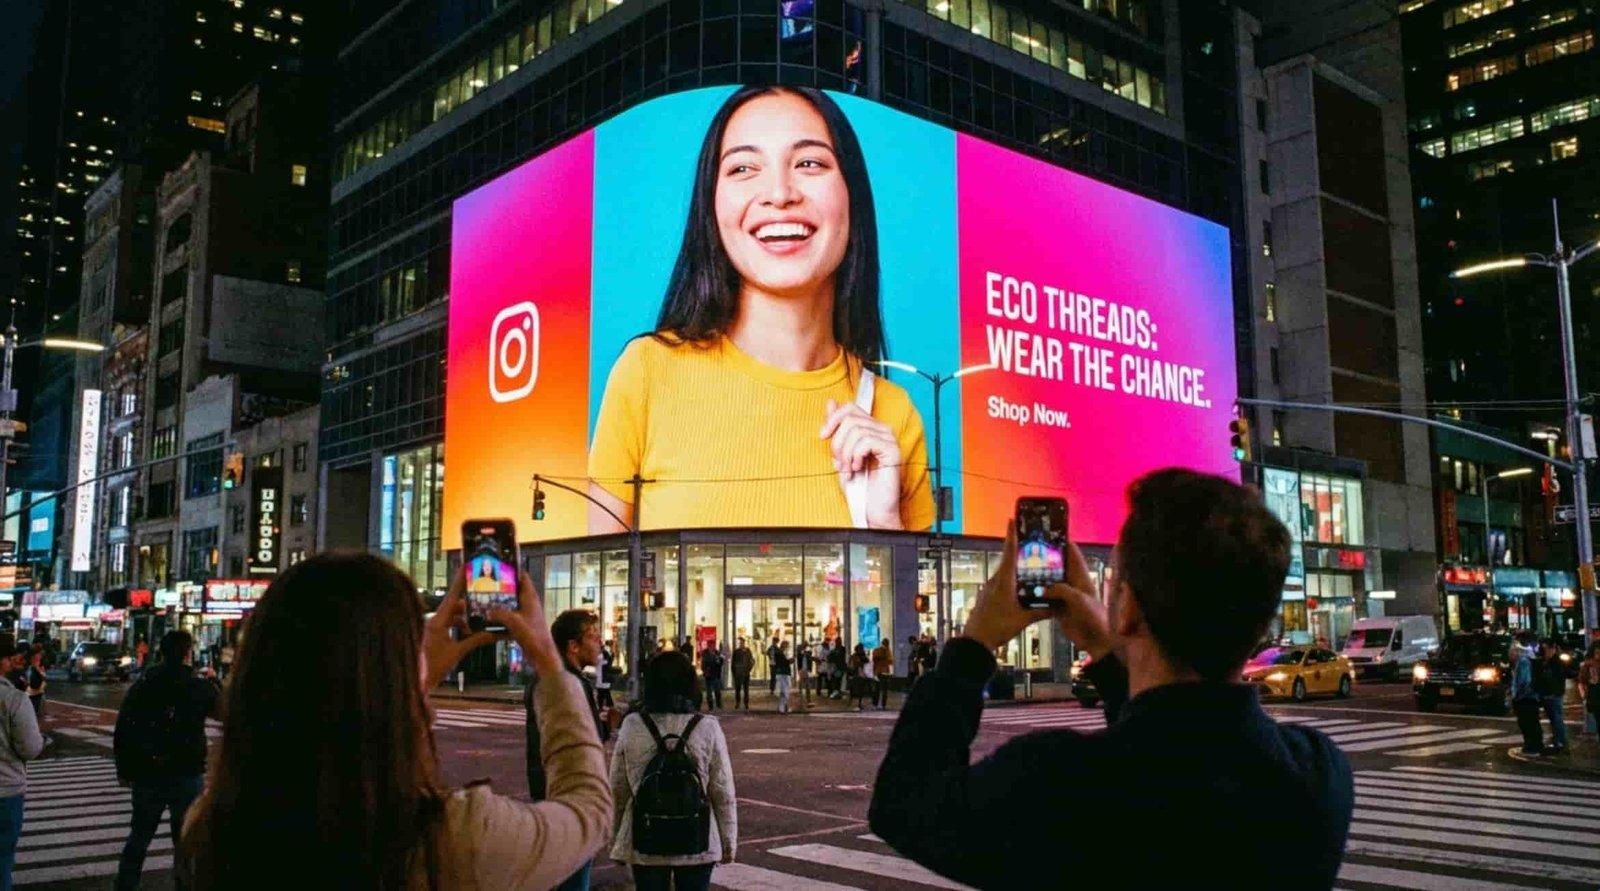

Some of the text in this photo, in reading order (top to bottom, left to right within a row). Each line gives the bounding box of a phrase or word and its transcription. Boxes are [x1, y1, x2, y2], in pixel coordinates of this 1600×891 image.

[986, 271, 1158, 351] ECO THREADS:
[986, 324, 1212, 408] WEAR THE CHANGE.
[987, 396, 1071, 428] Shop Now.
